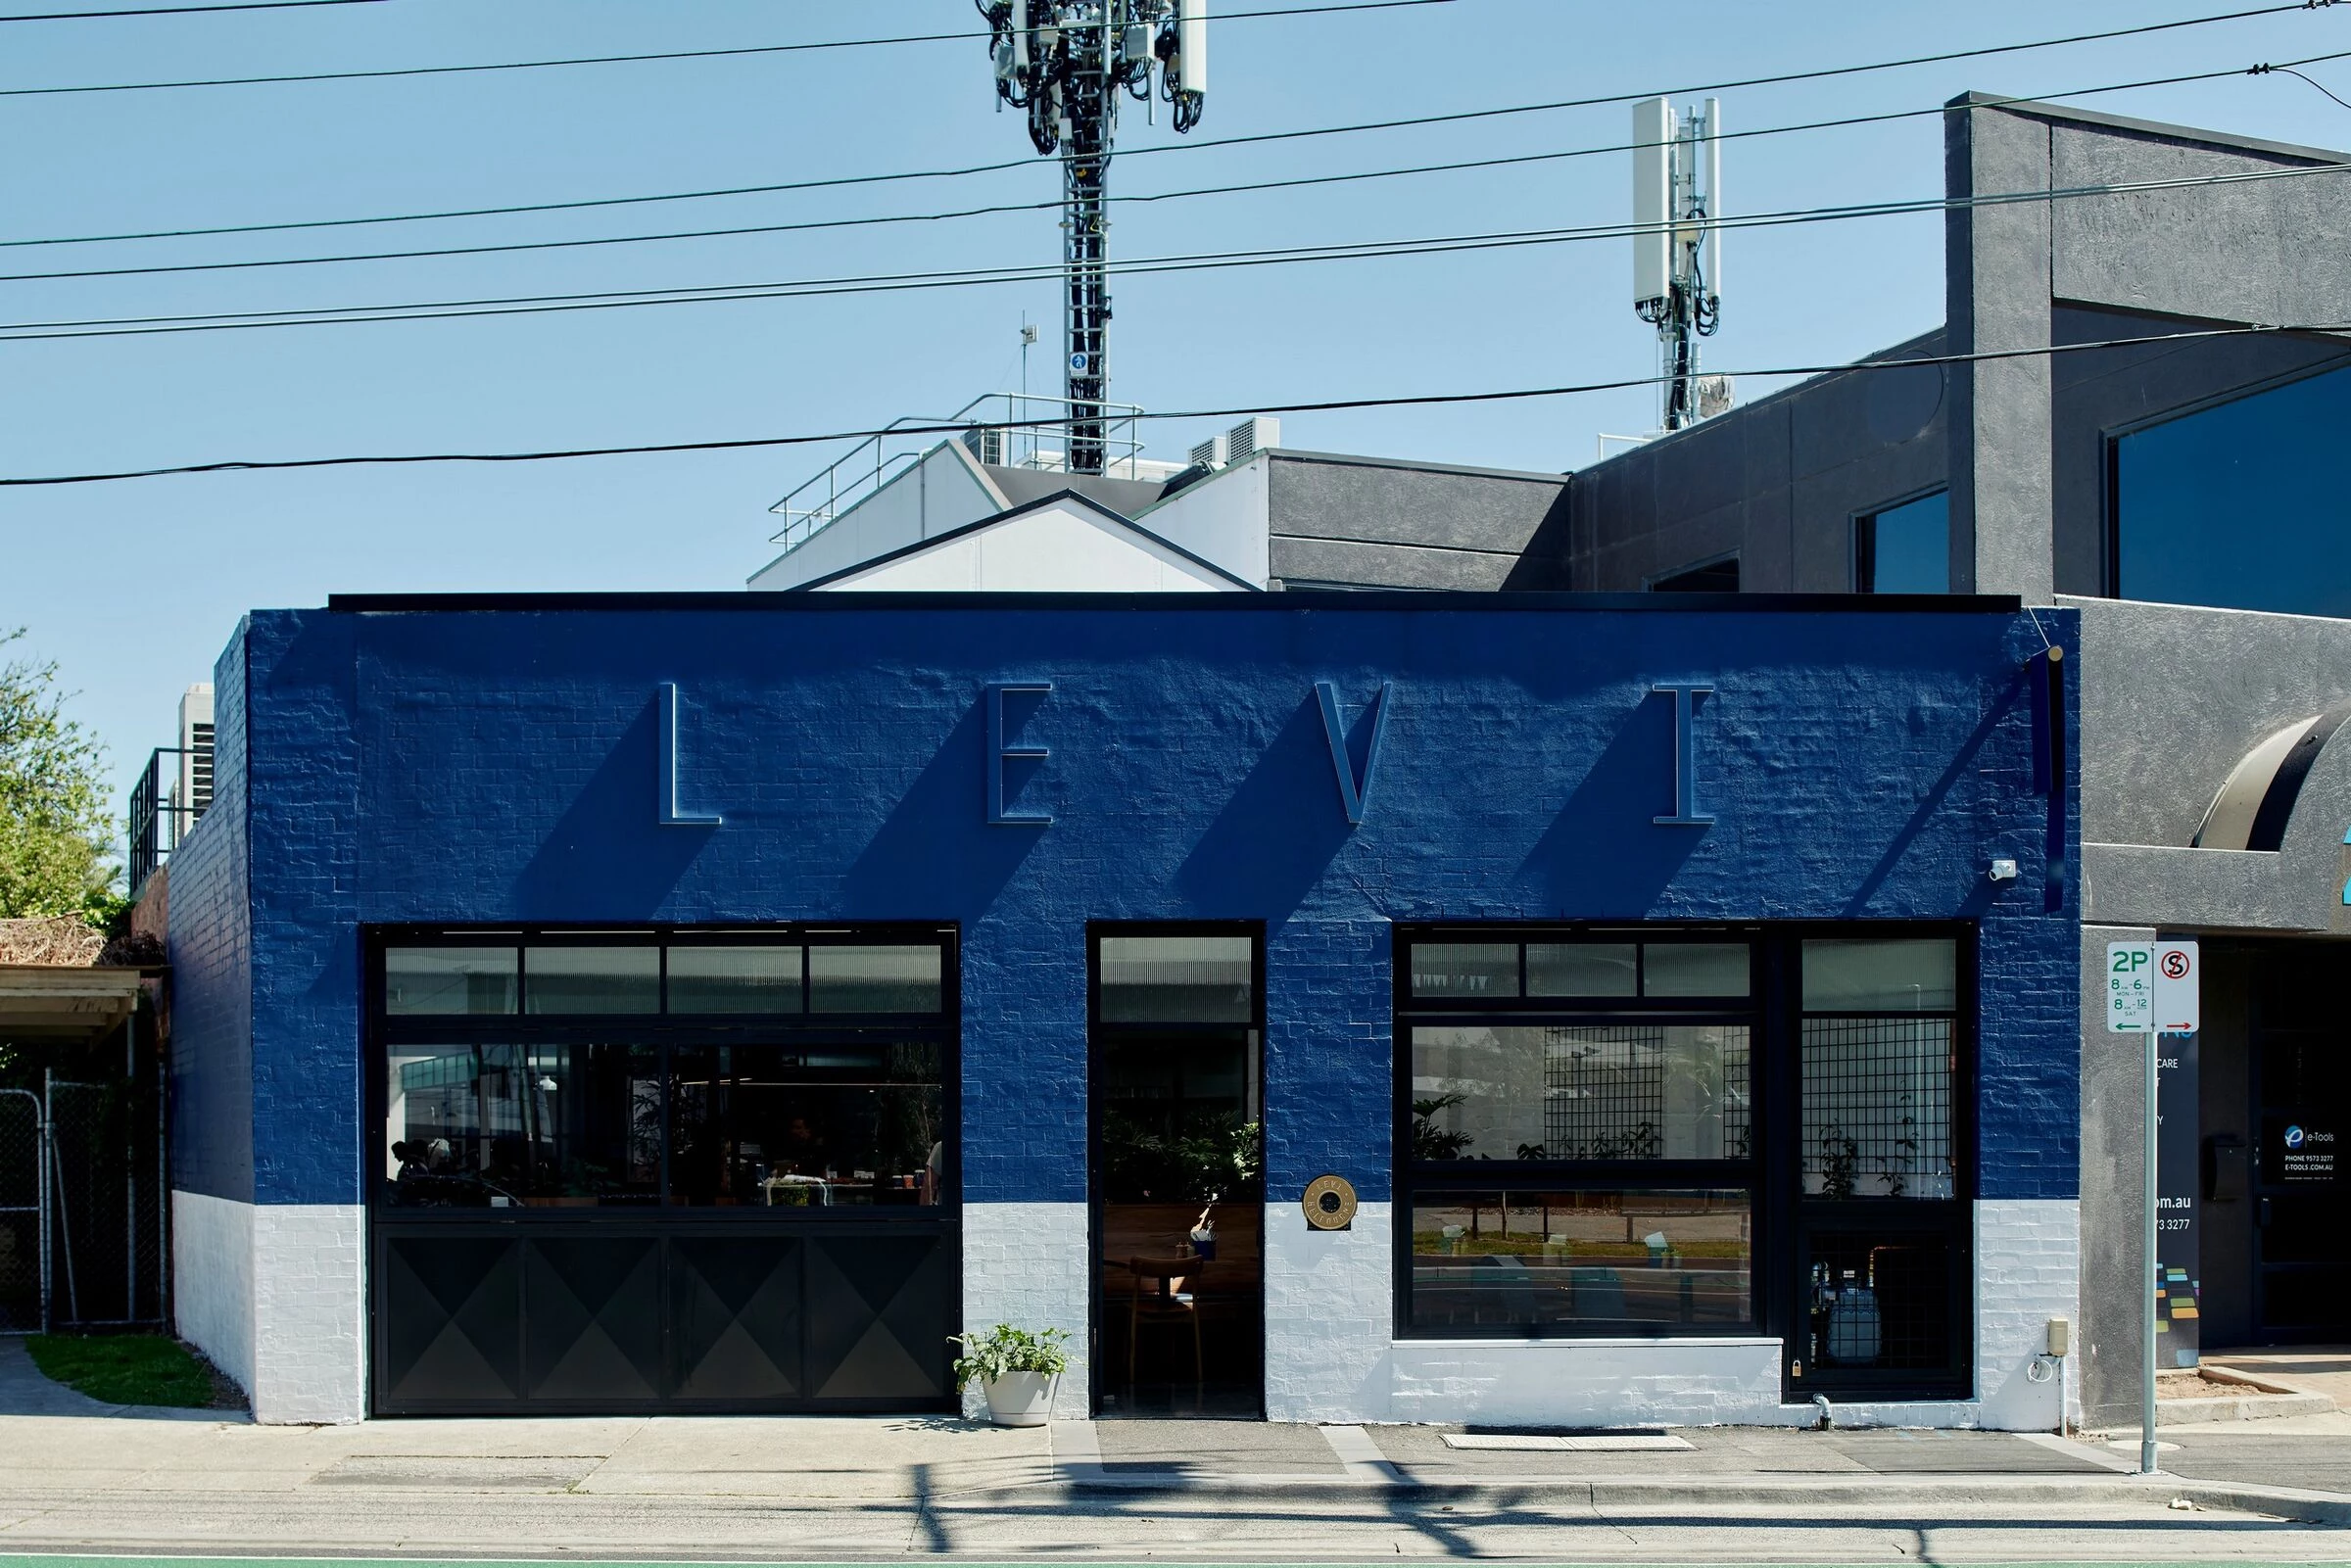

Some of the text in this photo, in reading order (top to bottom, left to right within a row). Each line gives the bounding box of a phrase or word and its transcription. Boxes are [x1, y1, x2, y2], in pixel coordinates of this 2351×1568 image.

[658, 682, 1715, 825] LEVI
[2112, 951, 2148, 972] 2P
[1316, 1179, 1342, 1190] LEVI
[2166, 1218, 2190, 1230] 3277
